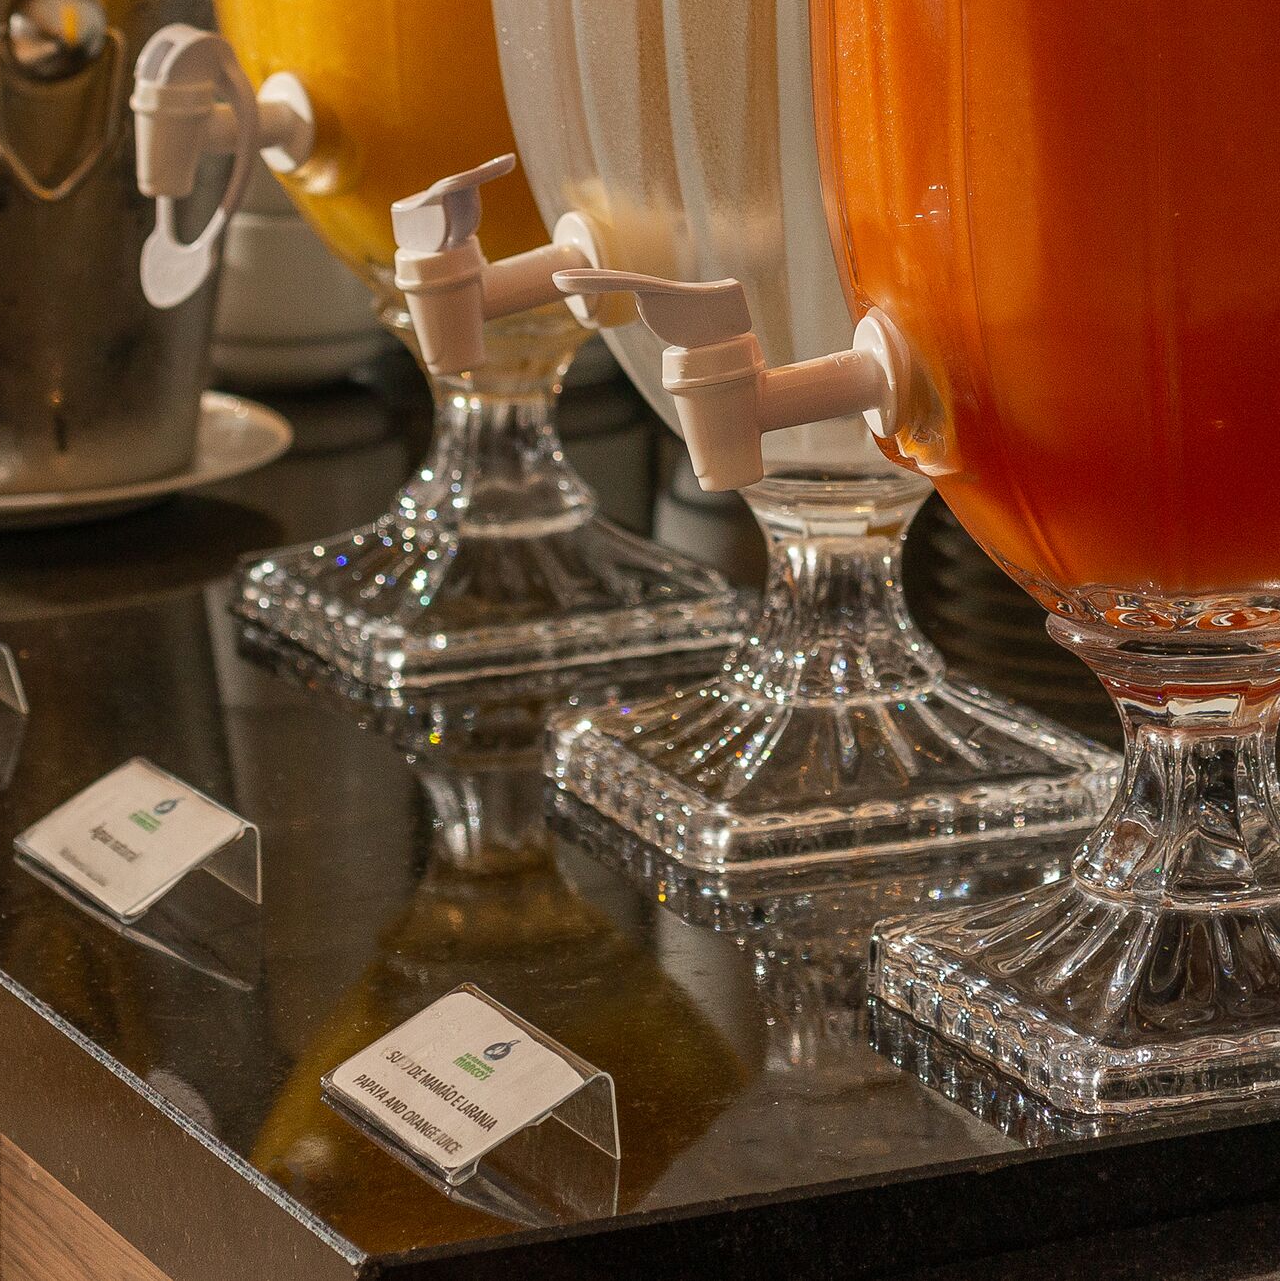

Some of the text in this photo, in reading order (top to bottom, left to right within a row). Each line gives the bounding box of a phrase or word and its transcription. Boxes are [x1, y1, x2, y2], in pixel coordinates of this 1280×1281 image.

[352, 1074, 463, 1155] PAPAYA AND ORANGE JUICE
[386, 1050, 498, 1132] SUO DE MAMÃO E LARANJA
